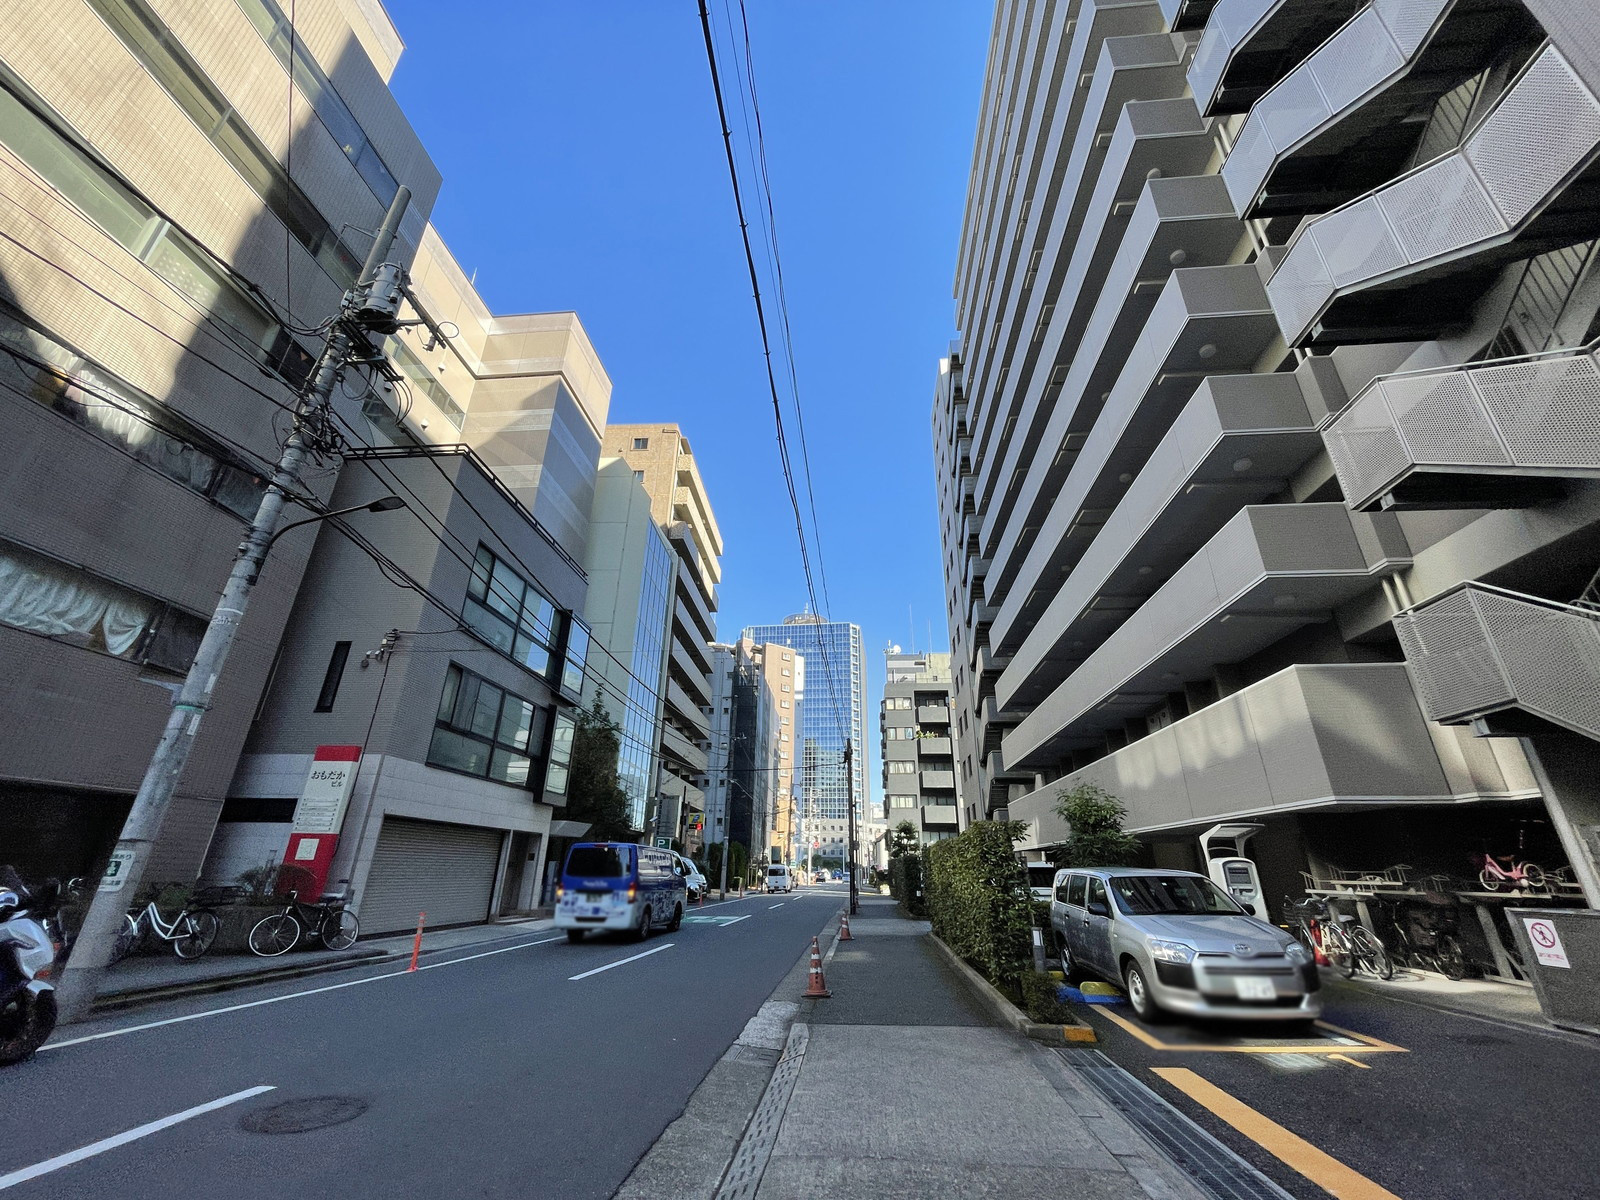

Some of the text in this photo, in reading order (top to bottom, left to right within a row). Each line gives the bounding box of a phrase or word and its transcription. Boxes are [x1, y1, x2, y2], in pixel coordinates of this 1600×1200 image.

[311, 770, 345, 780] おもだか
[657, 839, 665, 848] P
